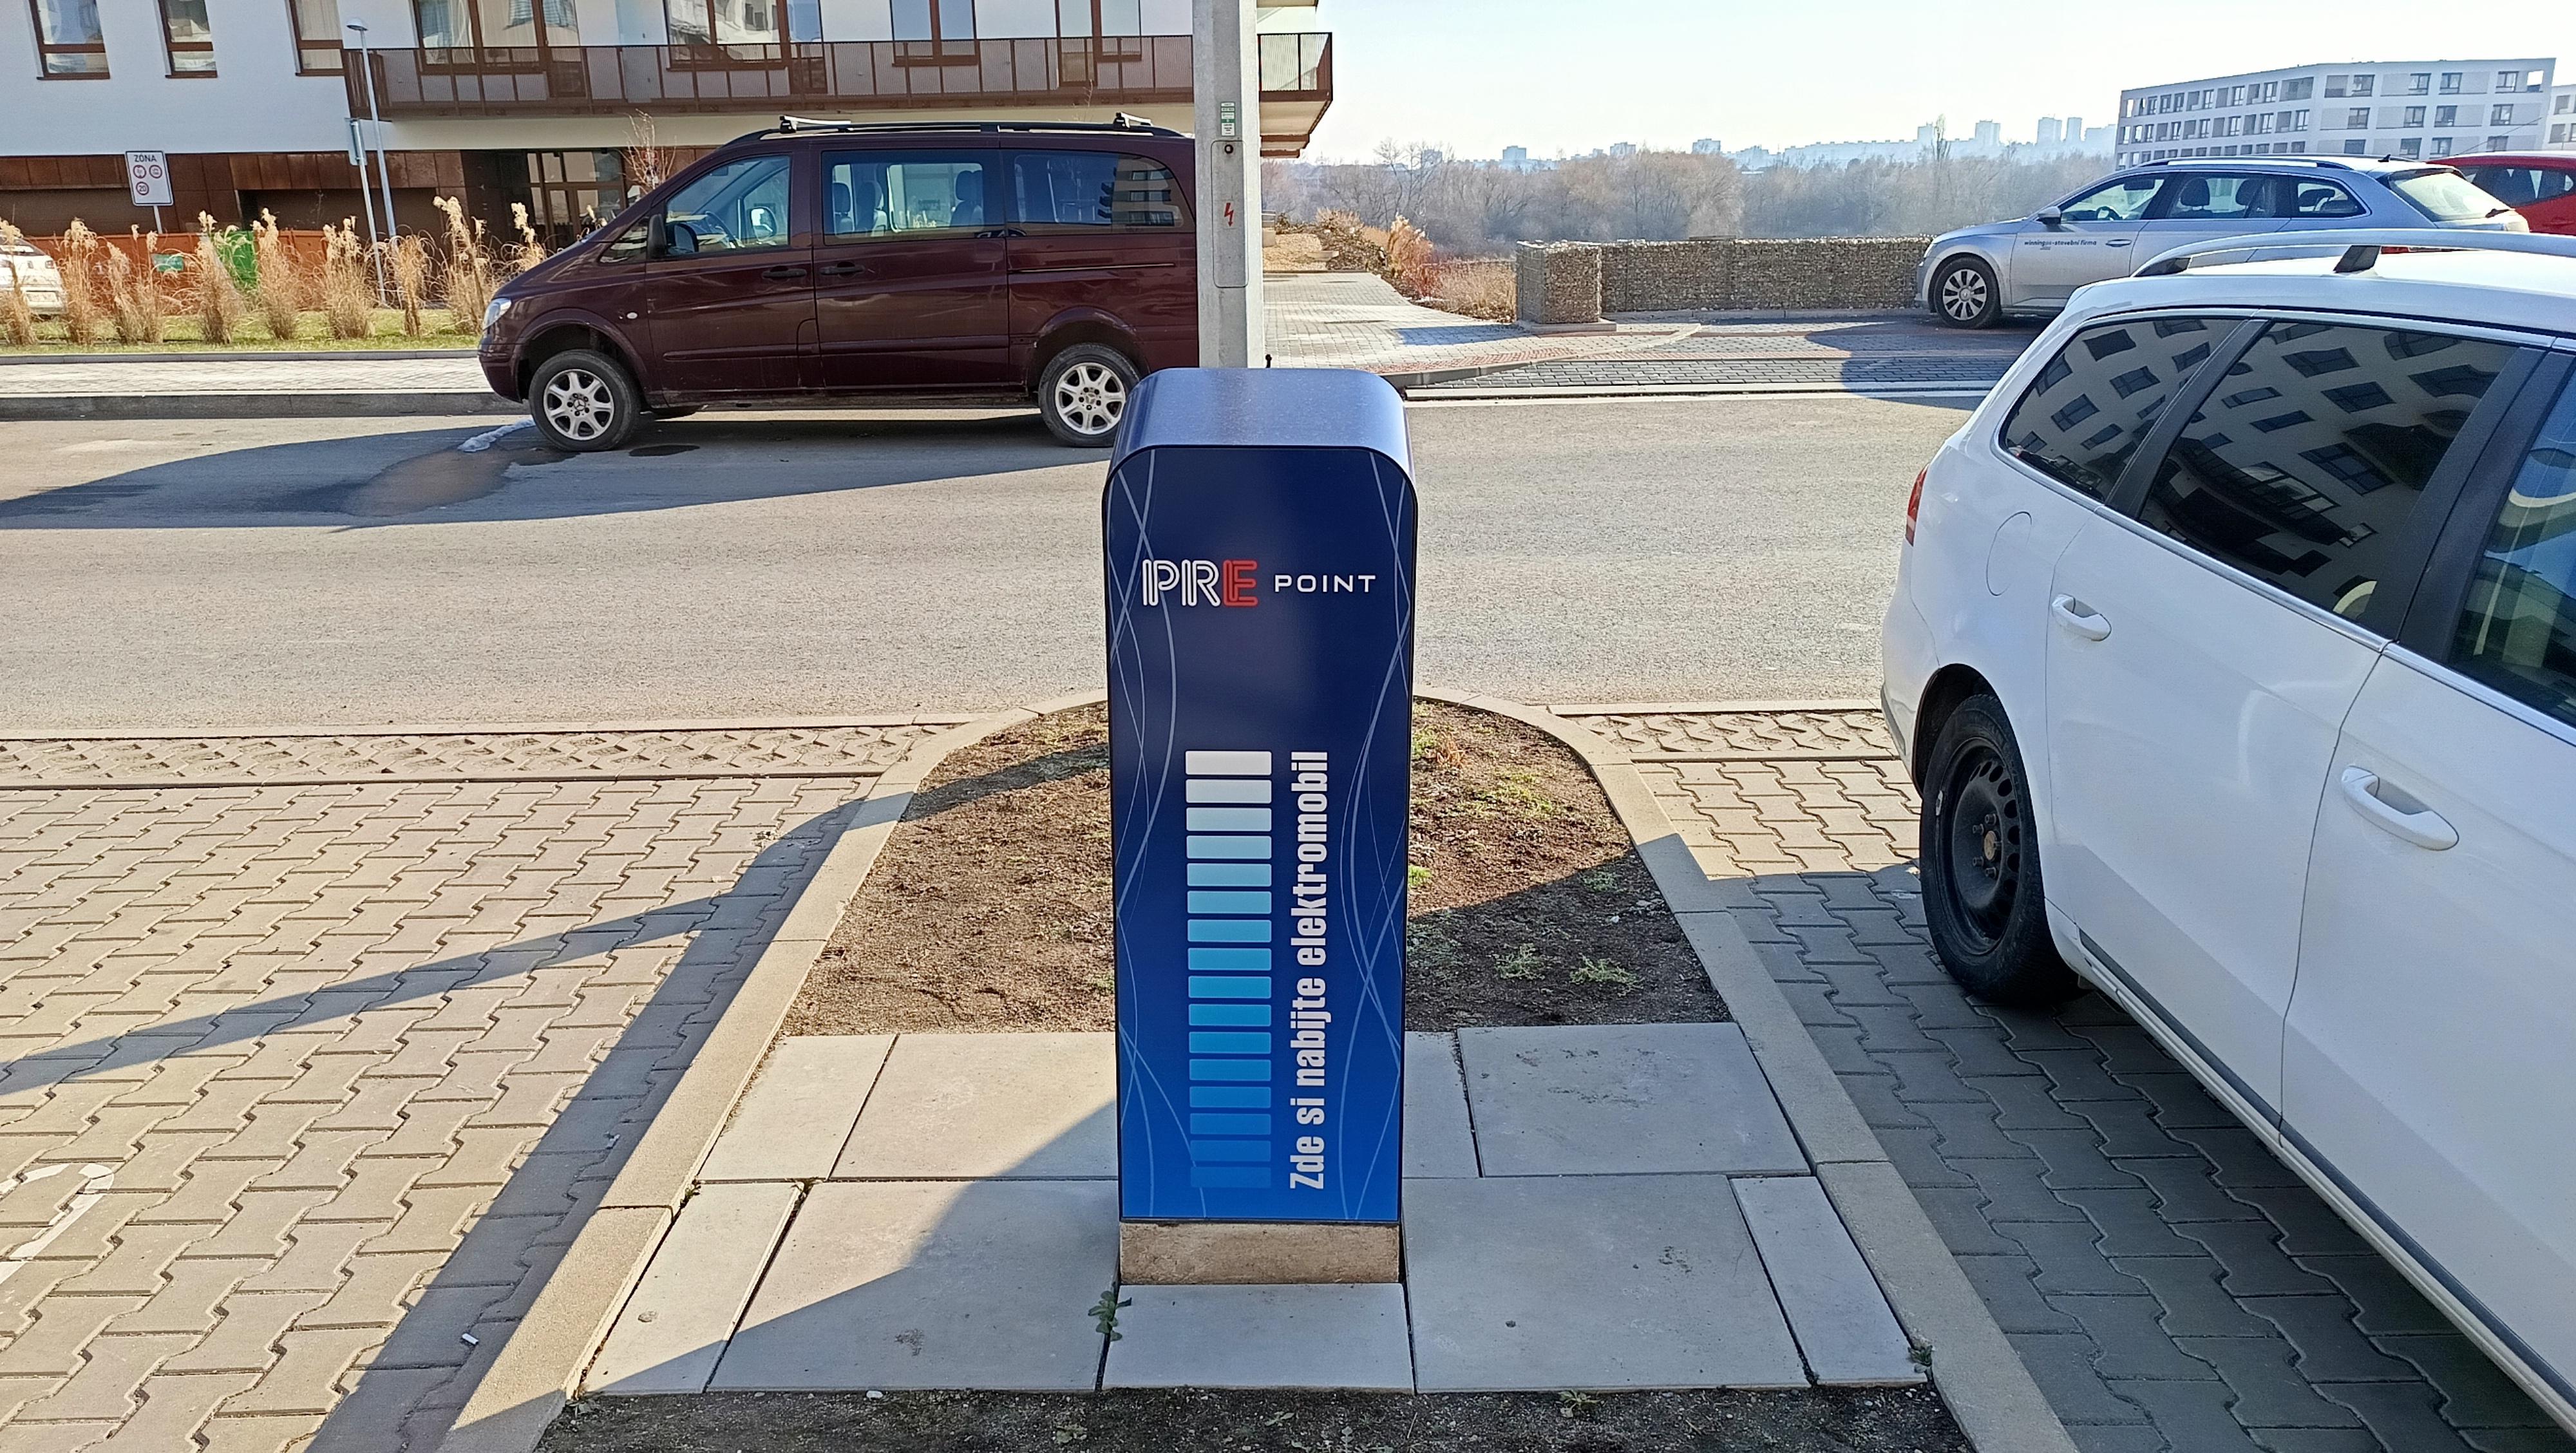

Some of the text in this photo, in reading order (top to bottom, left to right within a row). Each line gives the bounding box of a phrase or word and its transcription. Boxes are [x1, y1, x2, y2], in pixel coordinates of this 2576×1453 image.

[1142, 559, 1376, 607] PRE POINT
[1290, 752, 1332, 1189] Zde si nabijte elektromobil
